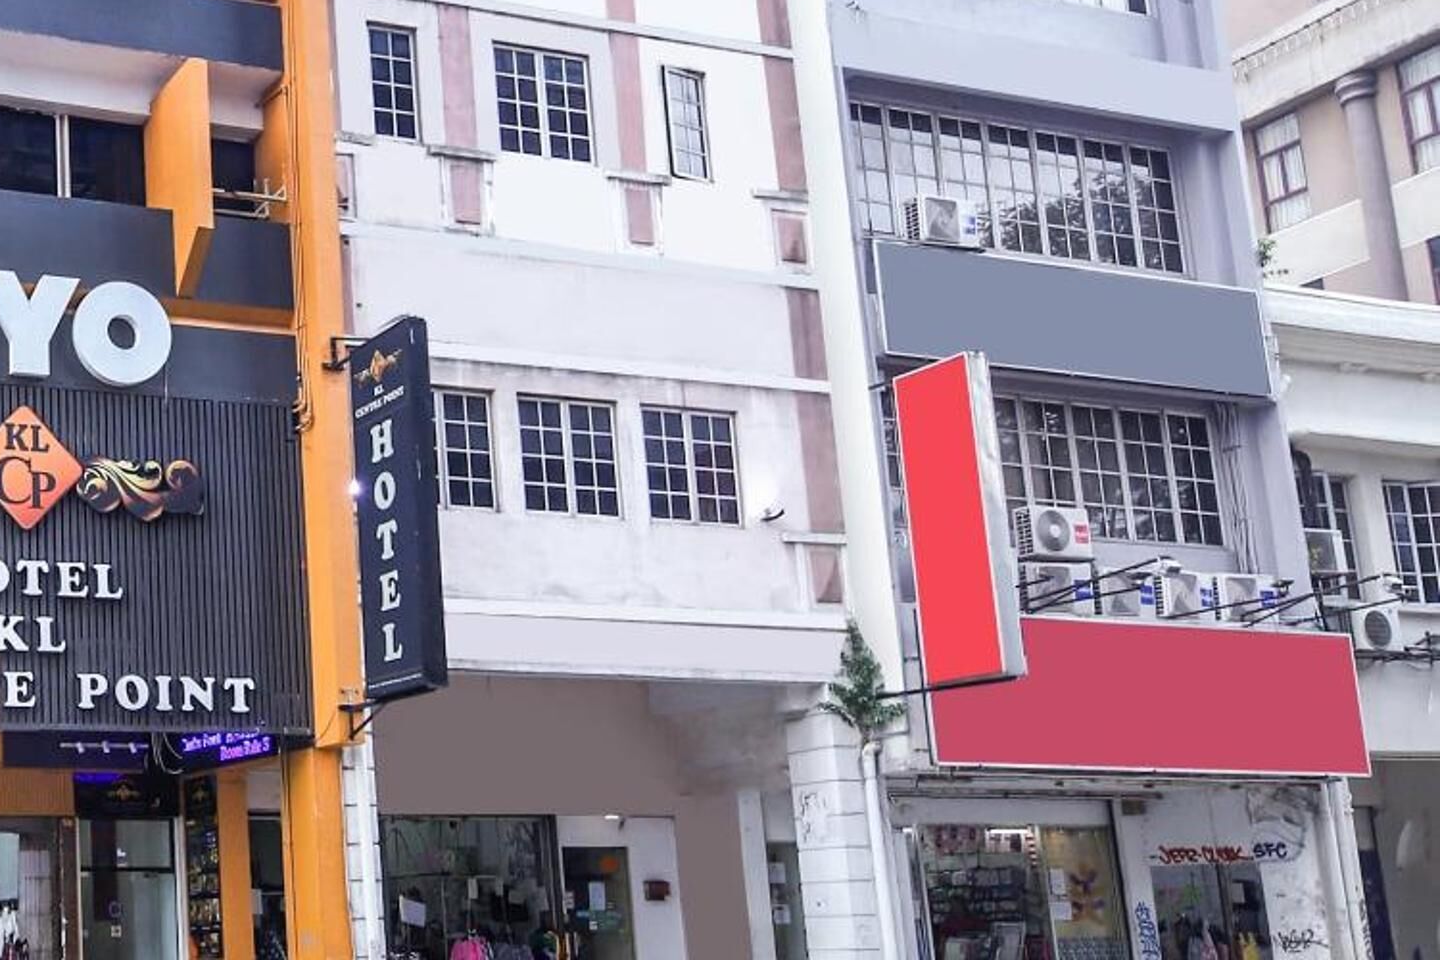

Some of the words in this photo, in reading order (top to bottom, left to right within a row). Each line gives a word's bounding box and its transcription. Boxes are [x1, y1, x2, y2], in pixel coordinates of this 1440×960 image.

[4, 422, 50, 453] KL
[370, 419, 403, 662] HOTEL
[76, 672, 257, 714] POINT
